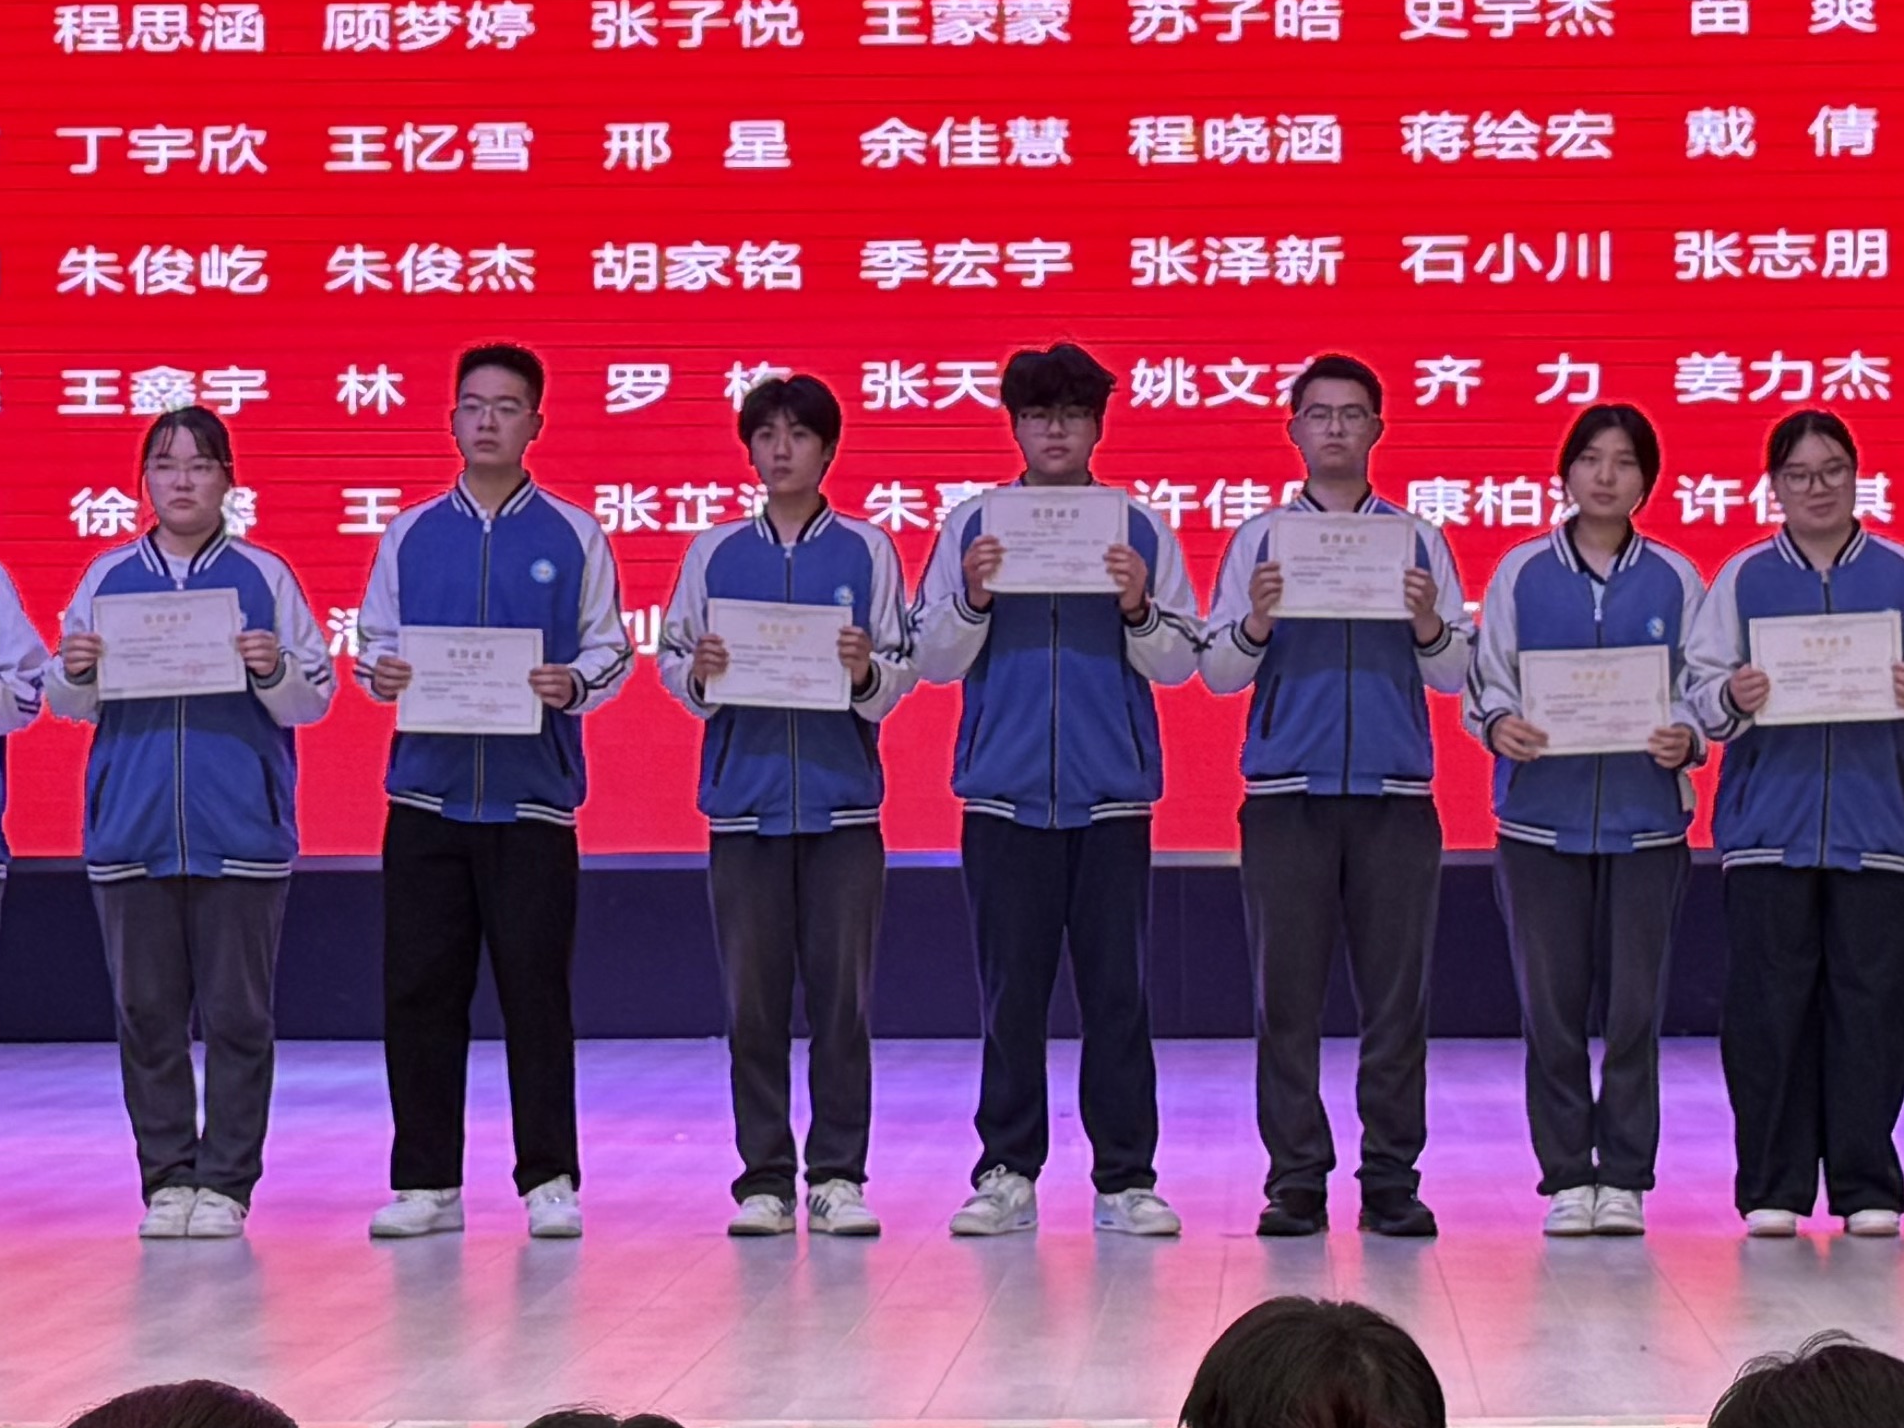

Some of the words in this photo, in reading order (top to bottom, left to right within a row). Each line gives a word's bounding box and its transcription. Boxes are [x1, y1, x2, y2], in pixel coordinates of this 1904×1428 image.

[55, 4, 264, 52] 程思涵
[324, 1, 534, 51] 顾梦婷
[57, 124, 266, 173] 丁宇欣
[326, 123, 533, 171] 王忆雪
[860, 117, 1071, 167] 余佳慧
[1129, 114, 1341, 164] 程晓涵
[1401, 110, 1613, 162] 蒋绘宏
[58, 245, 267, 295] 朱俊屹
[326, 243, 534, 293] 朱俊杰
[593, 241, 801, 290] 胡家铭
[860, 238, 1072, 288] 季宏宇
[1131, 235, 1343, 285] 张泽新
[1401, 232, 1609, 283] 石小川
[1675, 229, 1887, 279] 张志朋
[57, 365, 269, 415] 王鑫宇
[1675, 351, 1890, 402] 姜力杰
[1134, 478, 1305, 529] 许佳
